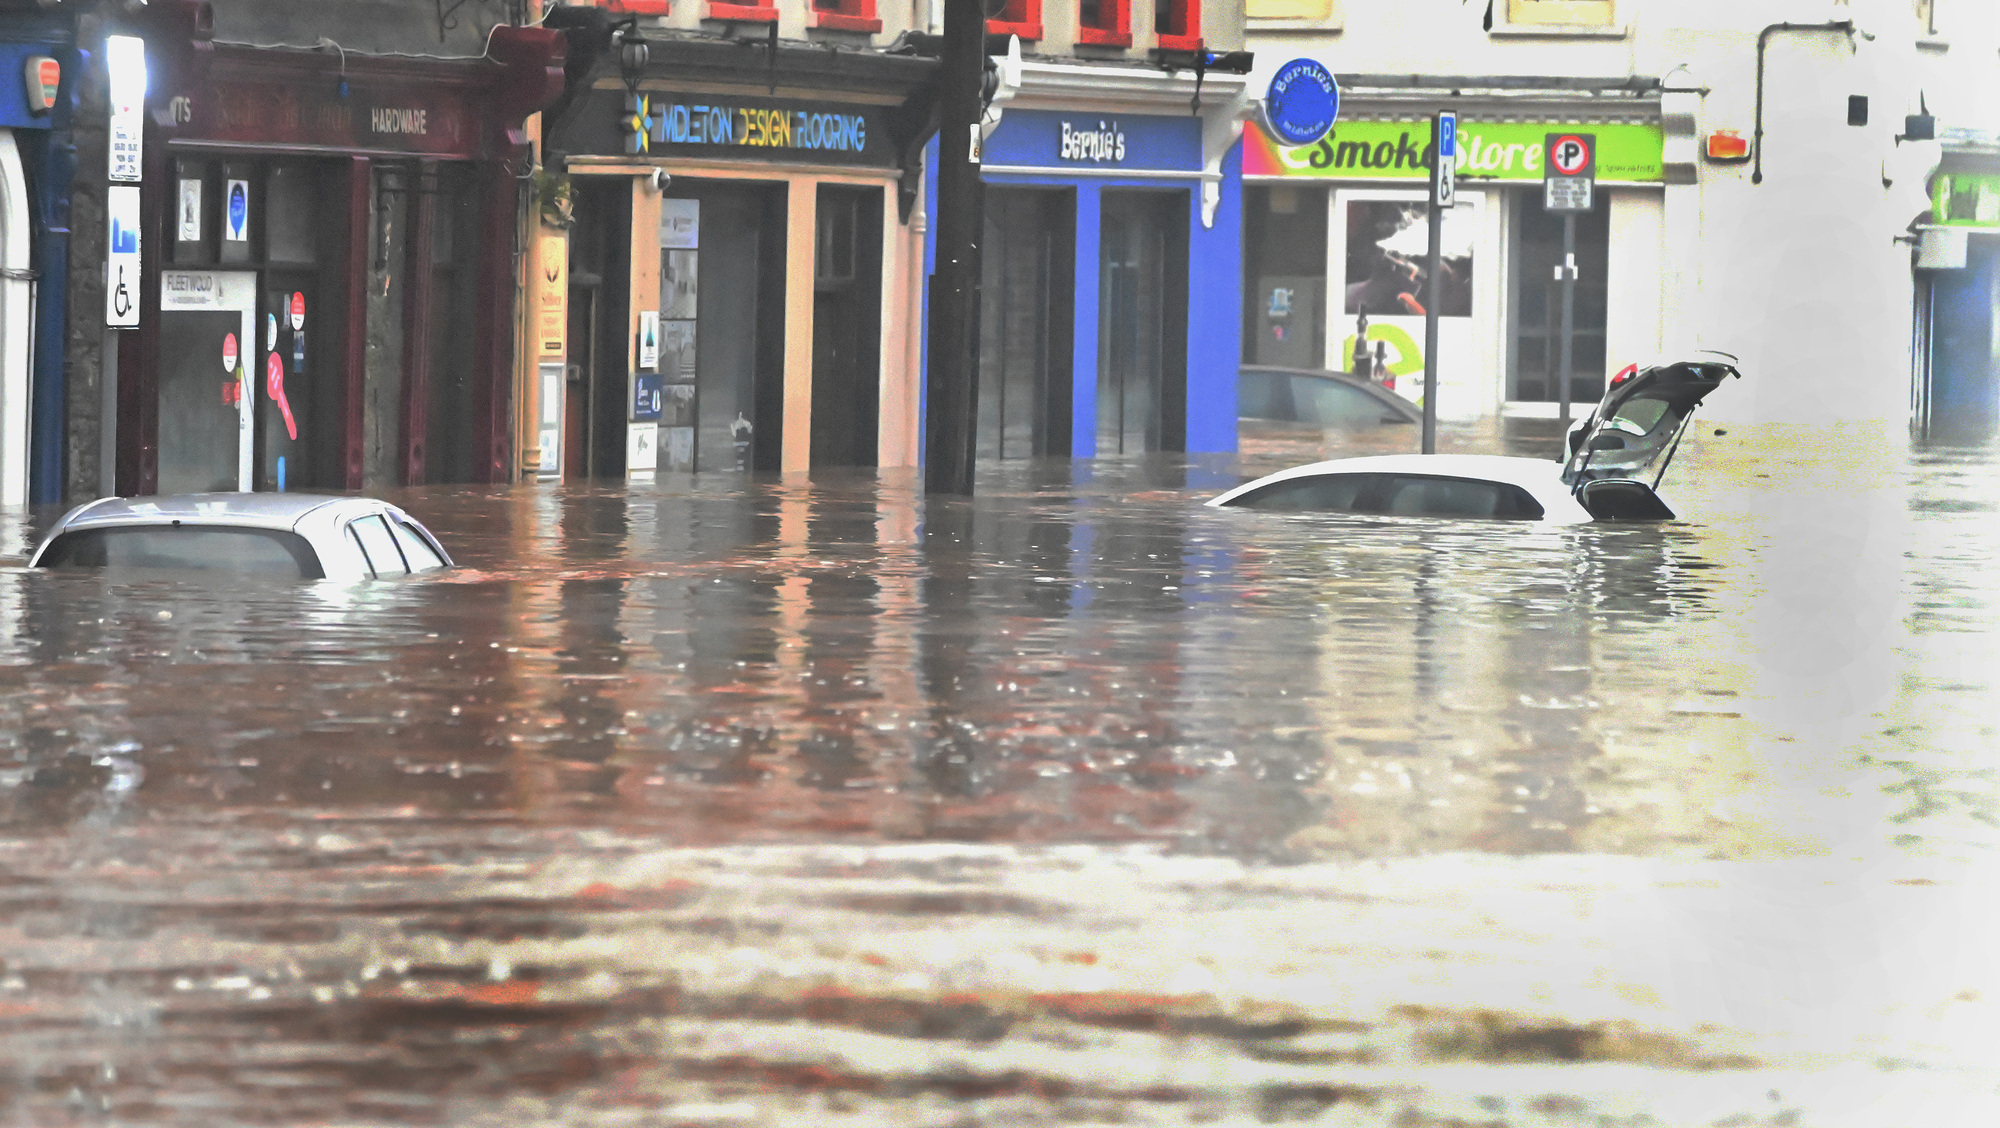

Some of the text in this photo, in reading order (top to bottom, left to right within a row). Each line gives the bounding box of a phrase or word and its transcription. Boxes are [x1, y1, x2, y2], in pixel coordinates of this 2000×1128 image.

[1274, 64, 1333, 94] Bernie's
[372, 108, 427, 135] HARDWARE
[739, 108, 791, 147] DESIGN
[797, 111, 866, 152] FLOORING
[1060, 120, 1125, 162] Bernie's
[1564, 142, 1580, 167] P
[166, 274, 213, 292] FLEETWOOD
